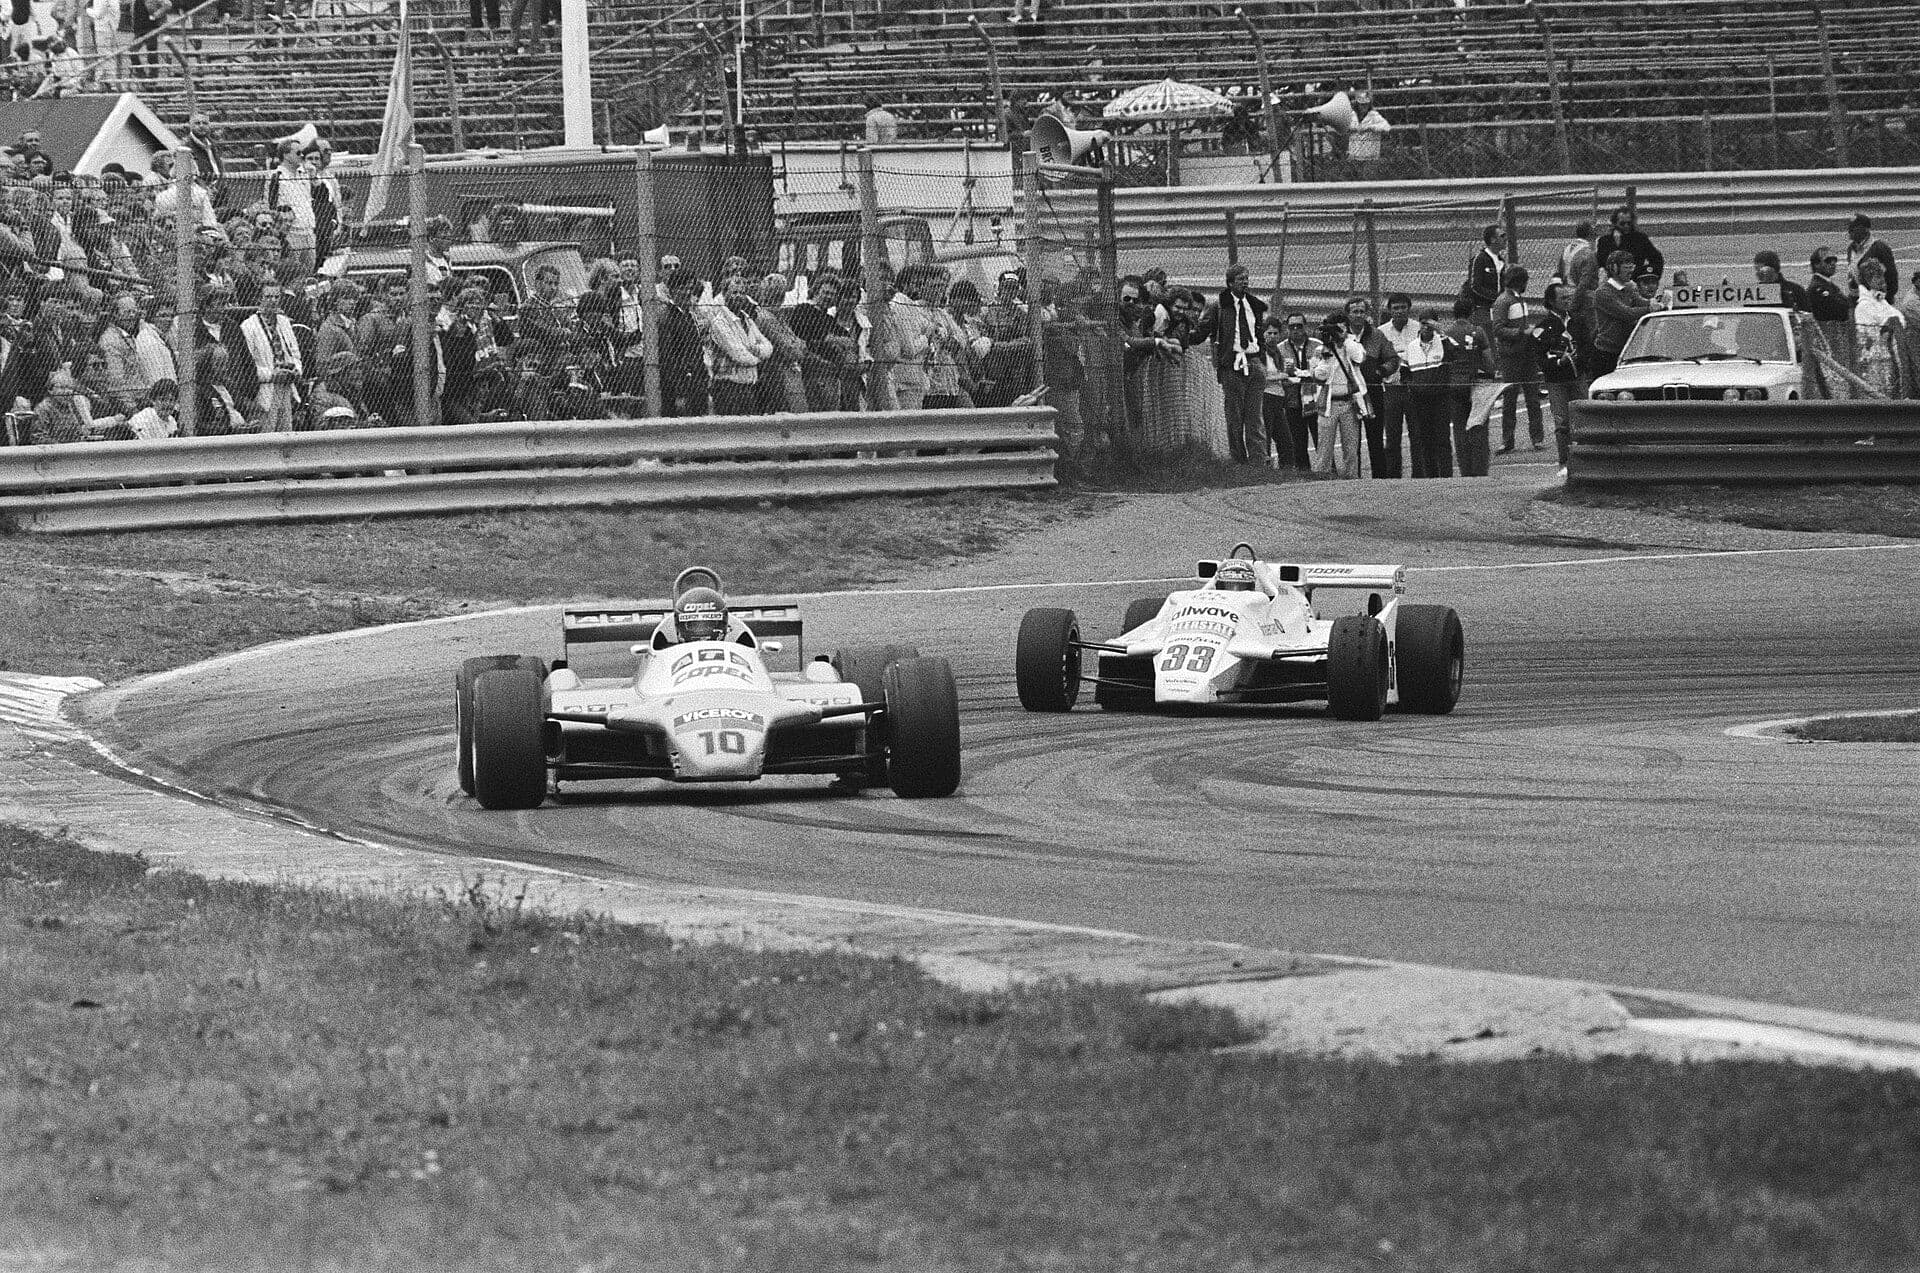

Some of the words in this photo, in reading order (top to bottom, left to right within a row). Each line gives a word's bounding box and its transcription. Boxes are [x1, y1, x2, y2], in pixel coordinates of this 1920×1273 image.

[1677, 287, 1766, 303] OFFICIAL
[1171, 606, 1239, 623] allwave
[1160, 644, 1216, 673] 33
[682, 708, 754, 723] VICEROY
[699, 731, 745, 755] 10
